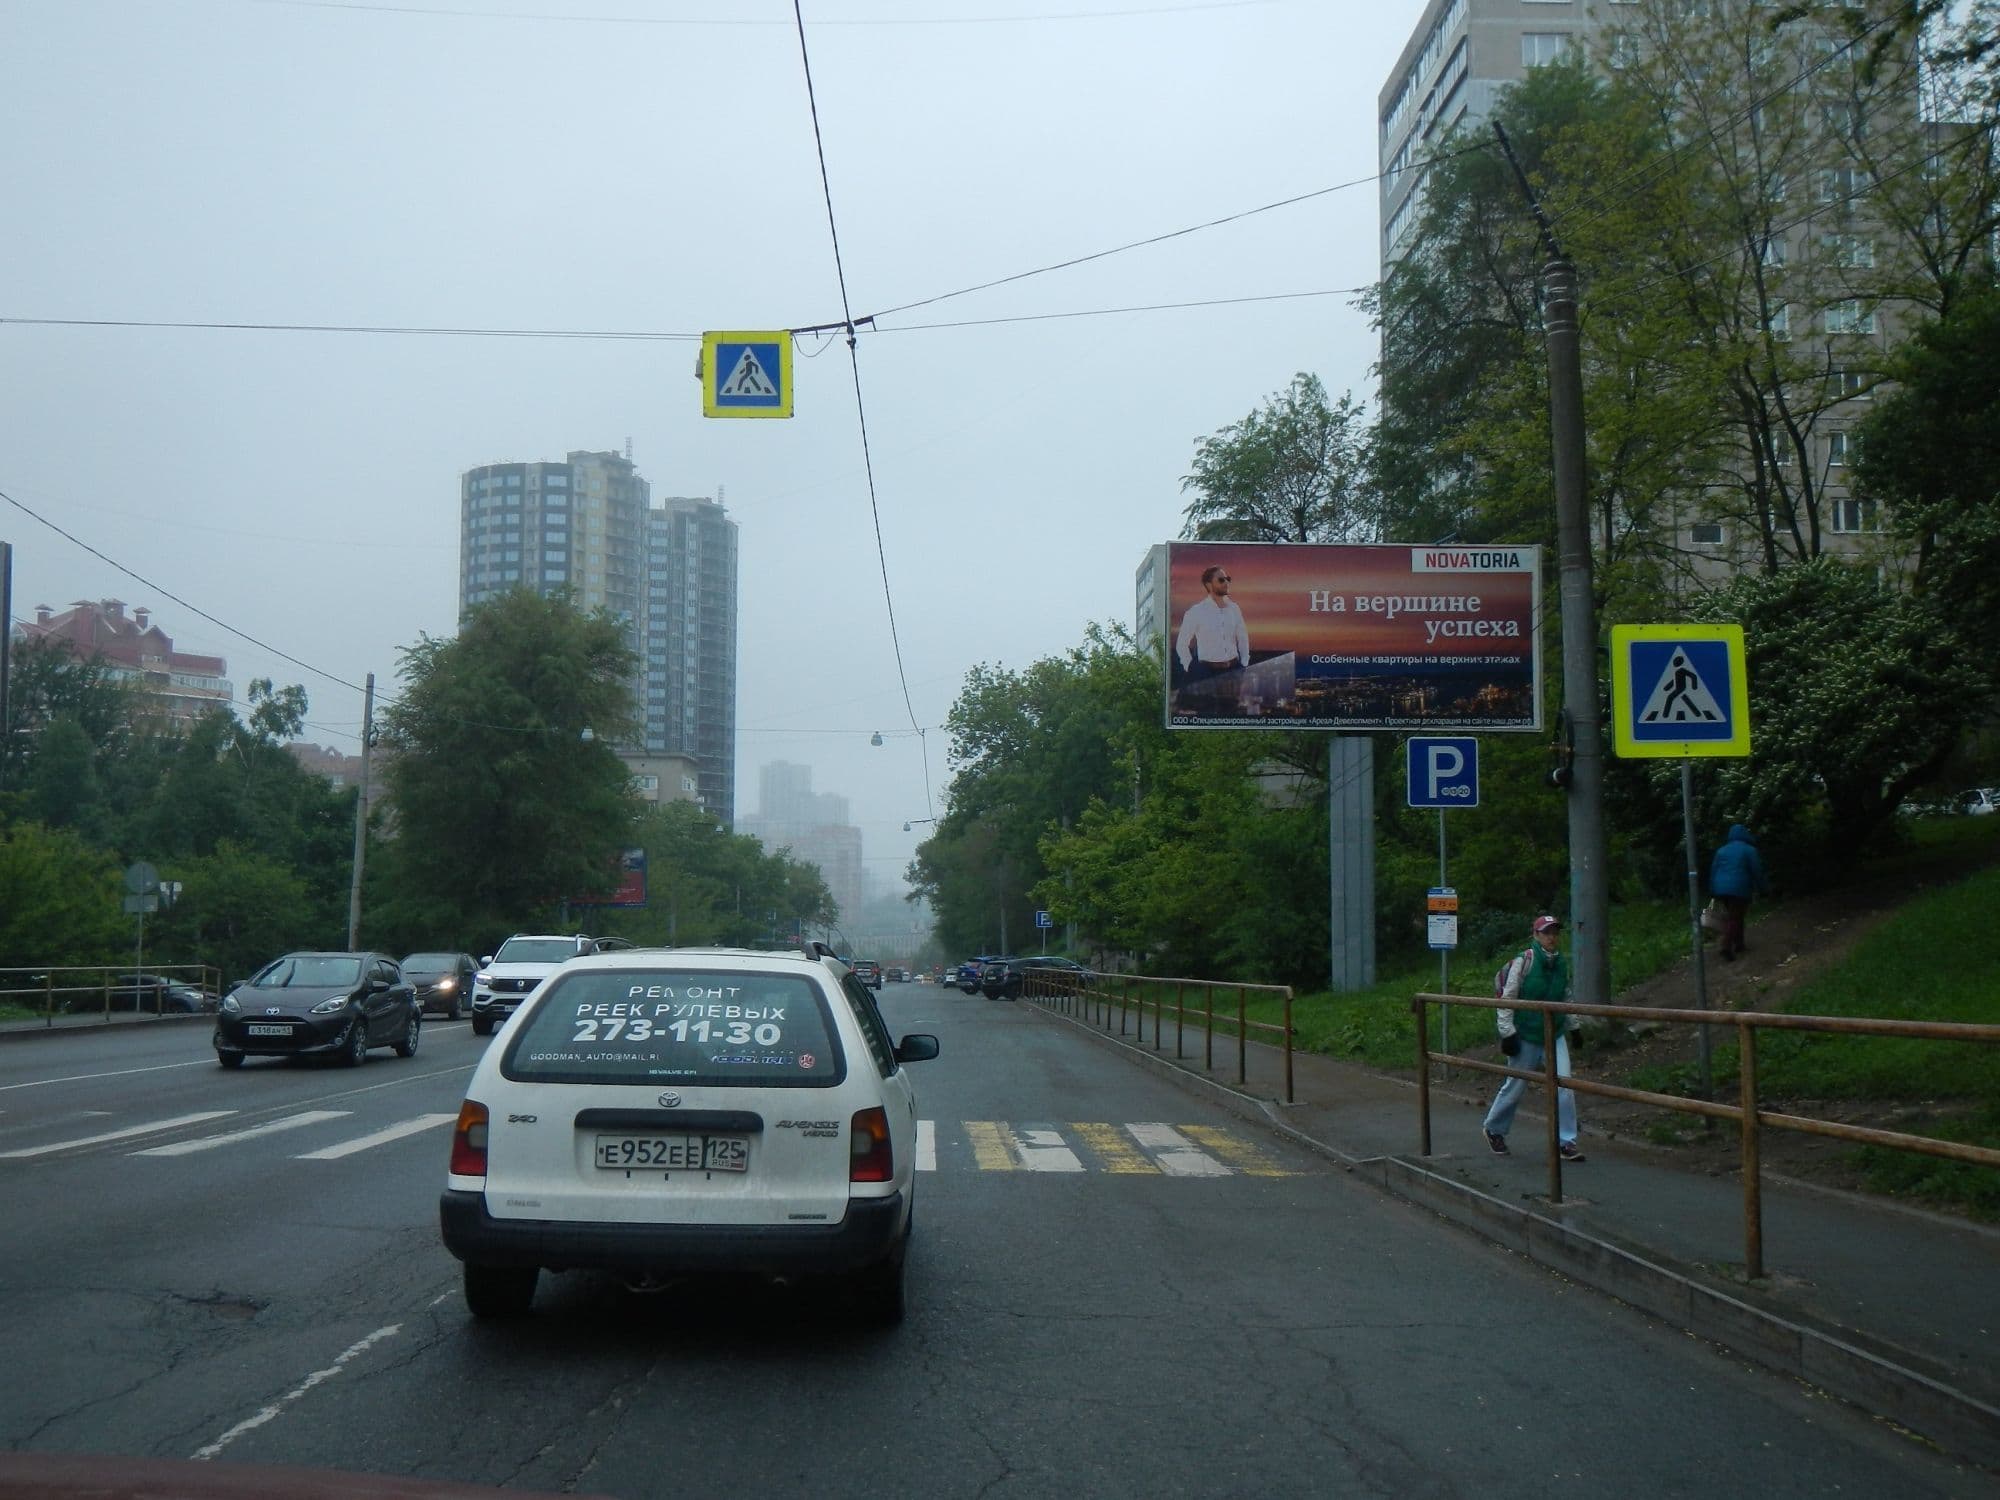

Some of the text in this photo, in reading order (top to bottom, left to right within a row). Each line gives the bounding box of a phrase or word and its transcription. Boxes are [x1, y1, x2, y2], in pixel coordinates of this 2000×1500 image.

[1426, 552, 1520, 568] NOVATORIA
[1310, 590, 1481, 619] На вершине
[1424, 619, 1519, 644] успеха
[1311, 654, 1370, 664] Особенные
[1372, 656, 1423, 666] квартиры
[1425, 656, 1438, 664] на
[1428, 745, 1464, 798] P
[577, 1004, 786, 1020] РЕЕК РУЛЕВЫХ
[572, 1019, 782, 1046] 273-11-30
[712, 1158, 730, 1167] RUS
